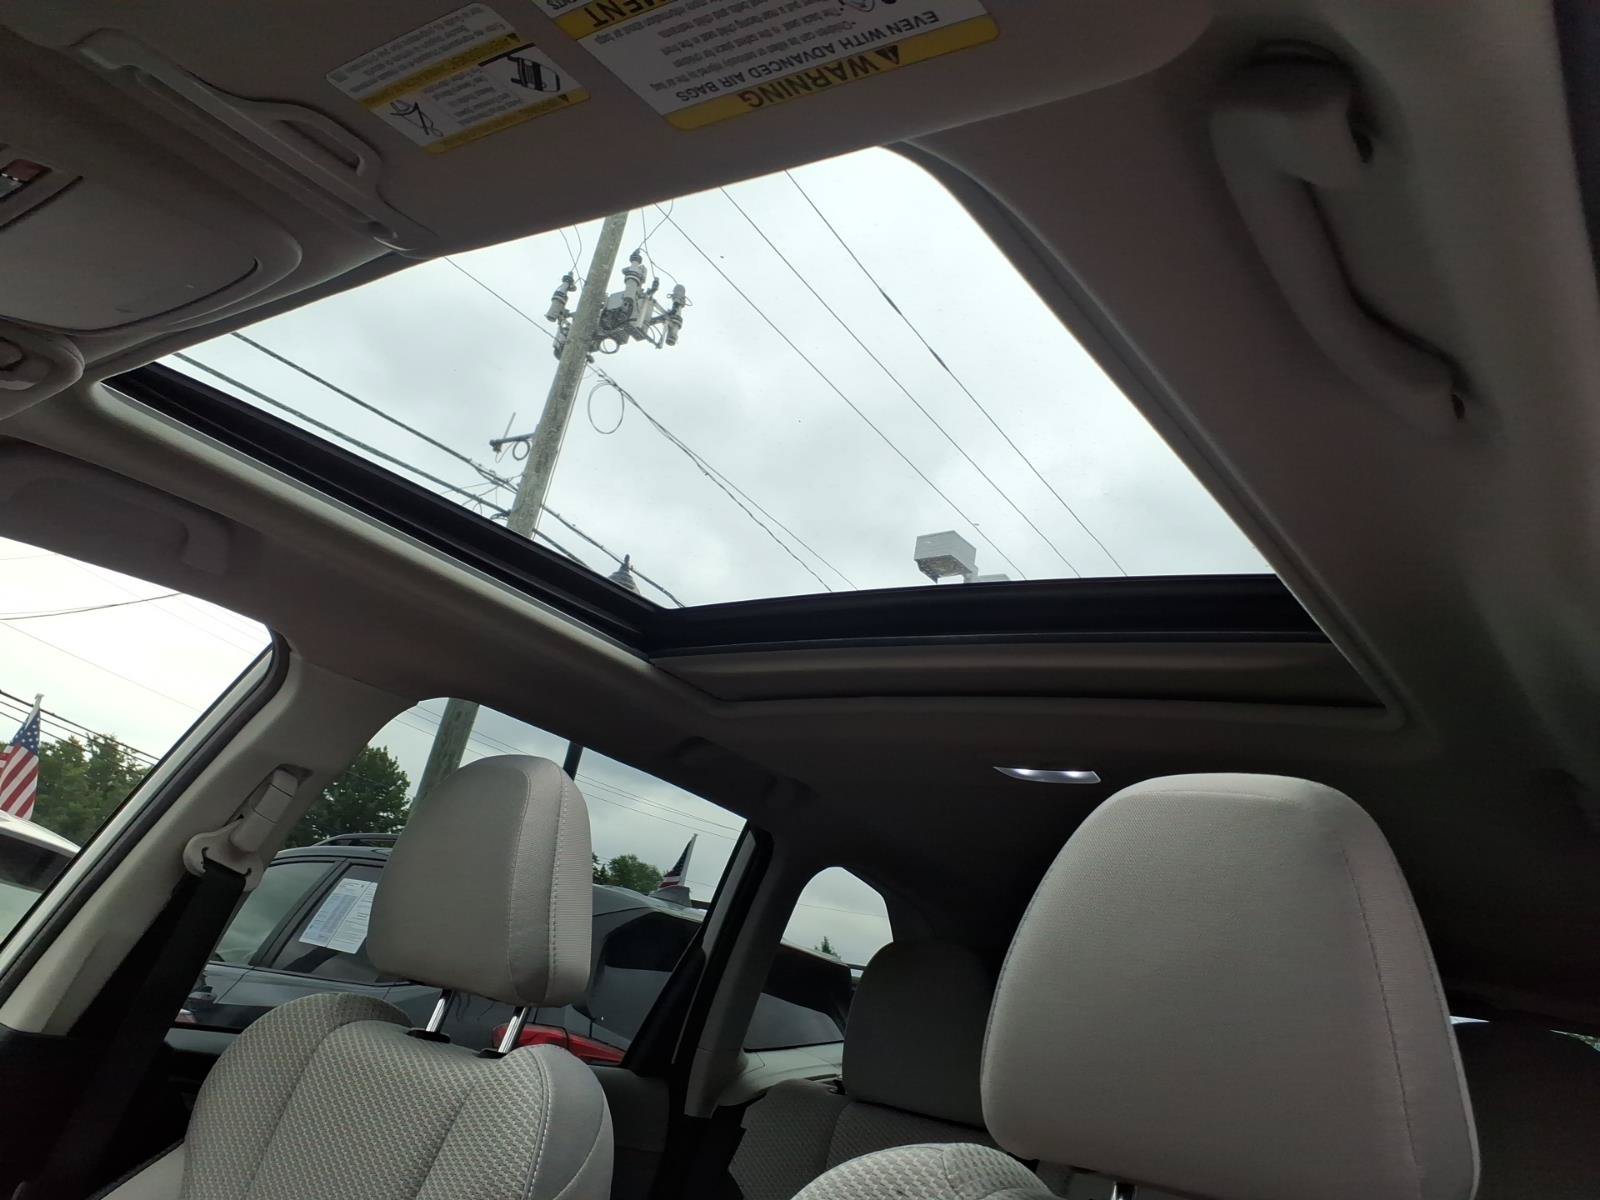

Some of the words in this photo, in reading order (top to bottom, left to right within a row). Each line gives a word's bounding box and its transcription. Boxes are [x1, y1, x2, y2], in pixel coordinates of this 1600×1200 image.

[886, 10, 940, 35] EVEN
[838, 27, 887, 50] WITH
[747, 42, 836, 79] ADVANCED
[675, 81, 720, 102] BAGS
[718, 72, 746, 88] AIR
[738, 54, 880, 108] WARNING
